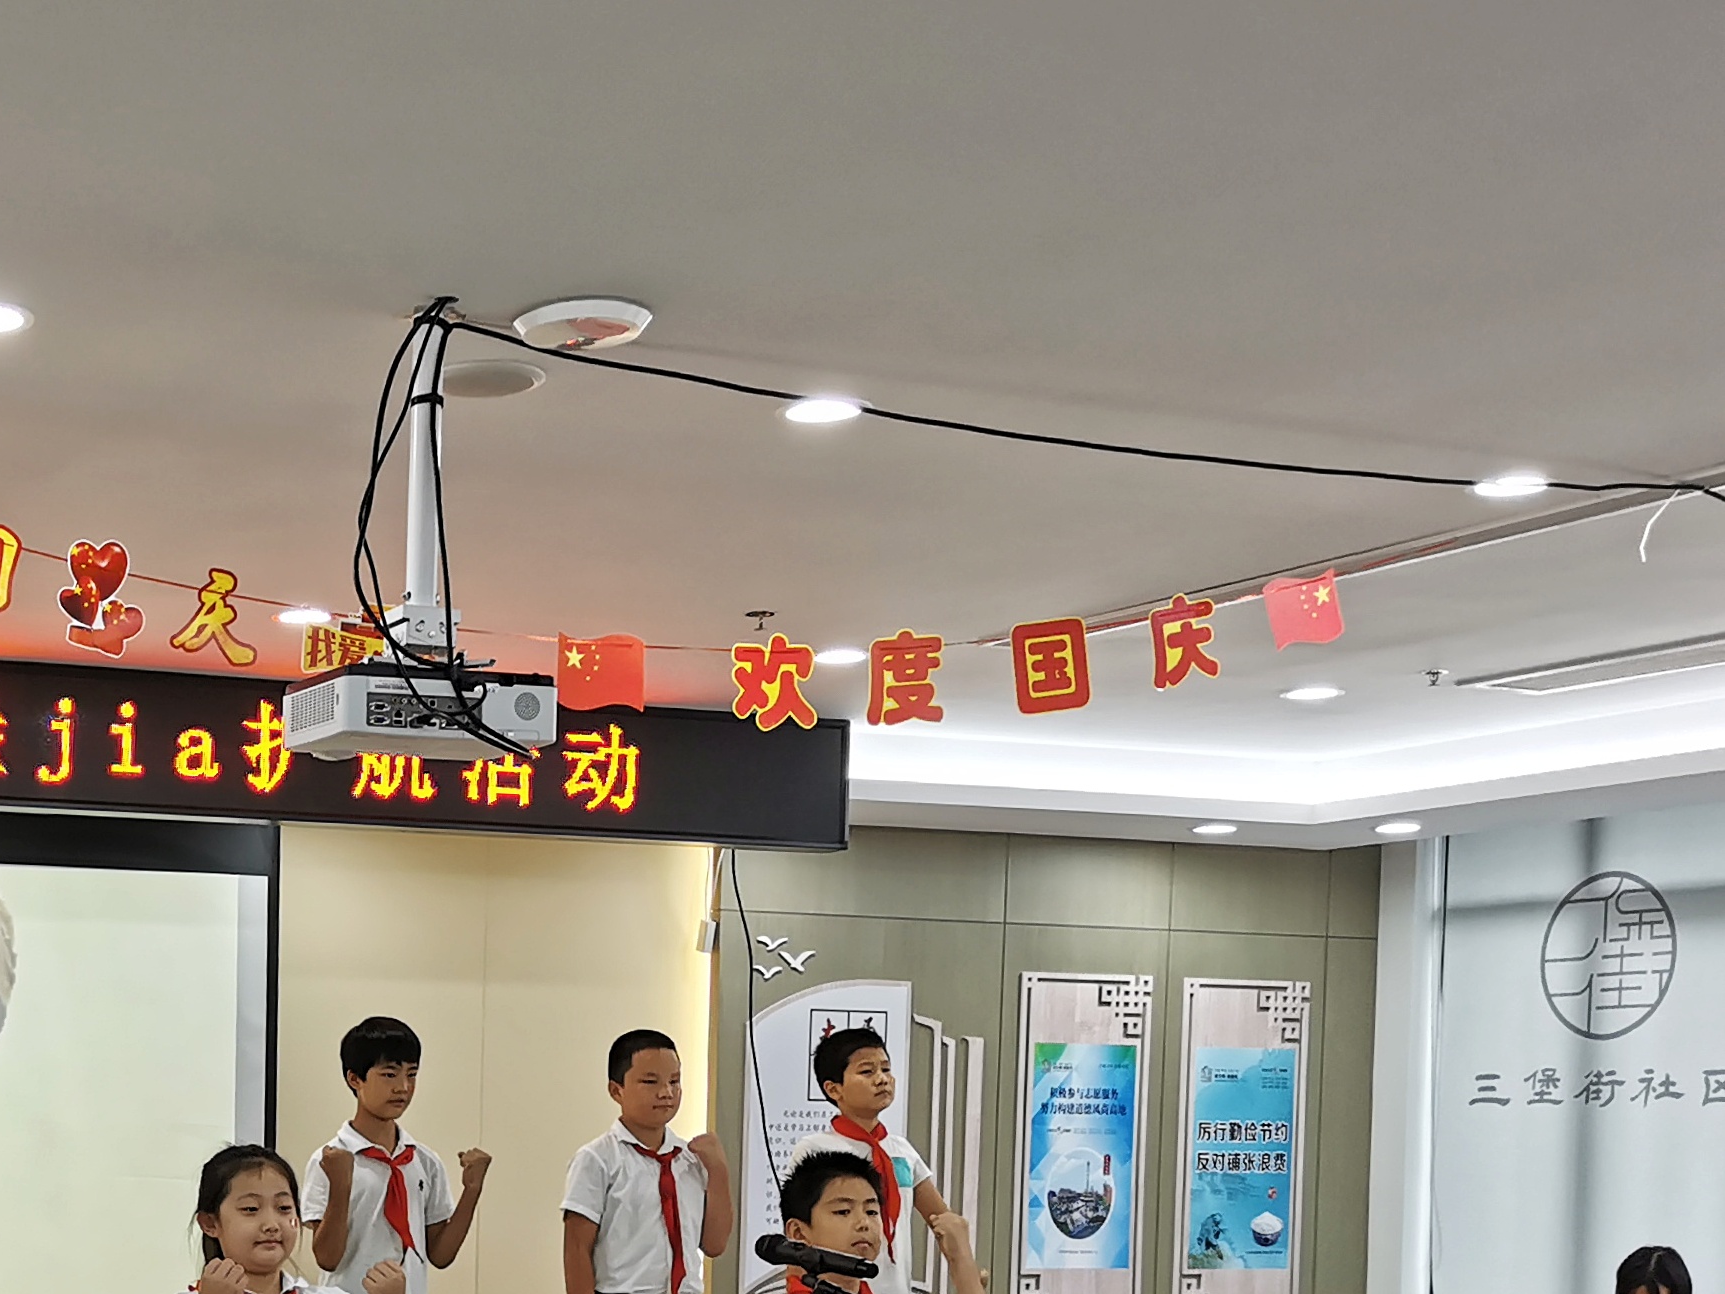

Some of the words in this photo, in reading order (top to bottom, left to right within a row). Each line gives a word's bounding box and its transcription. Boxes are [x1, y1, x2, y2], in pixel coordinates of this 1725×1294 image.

[732, 593, 1219, 731] 欢度国庆
[1468, 1067, 1725, 1109] 三堡街社区
[1196, 1121, 1289, 1142] 厉行勤俭节约
[1195, 1152, 1288, 1172] 反对铺张浪费
